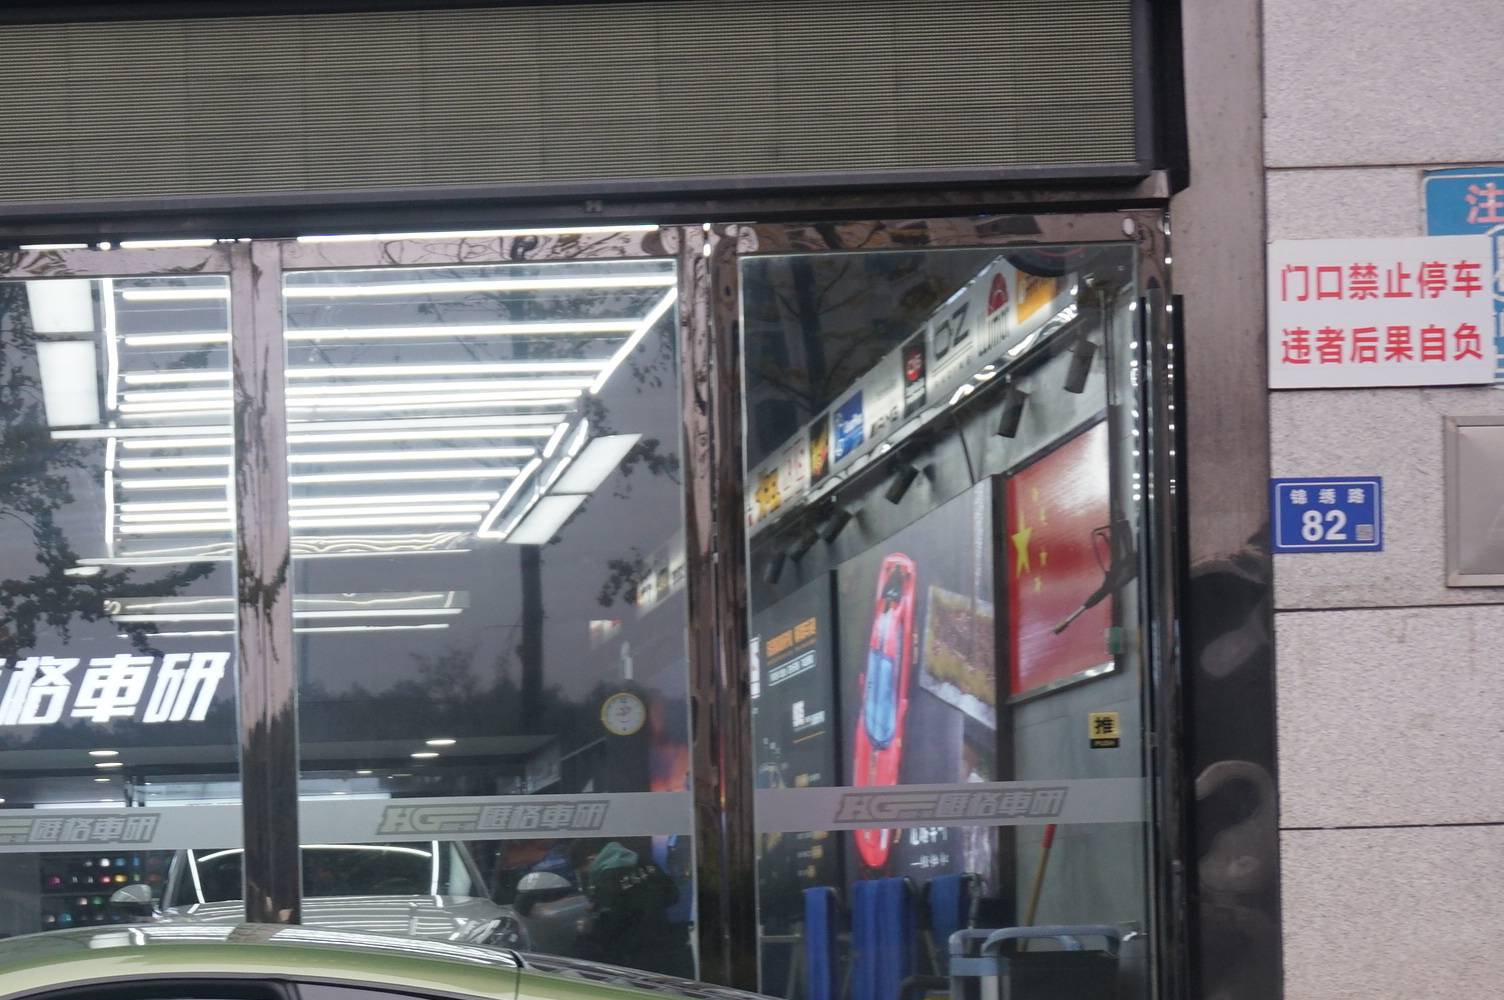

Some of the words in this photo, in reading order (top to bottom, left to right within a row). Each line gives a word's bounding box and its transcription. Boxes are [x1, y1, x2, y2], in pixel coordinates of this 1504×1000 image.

[1281, 260, 1483, 302] 门口禁止停车
[1281, 323, 1484, 365] 违者后果自负
[1301, 509, 1348, 541] 82
